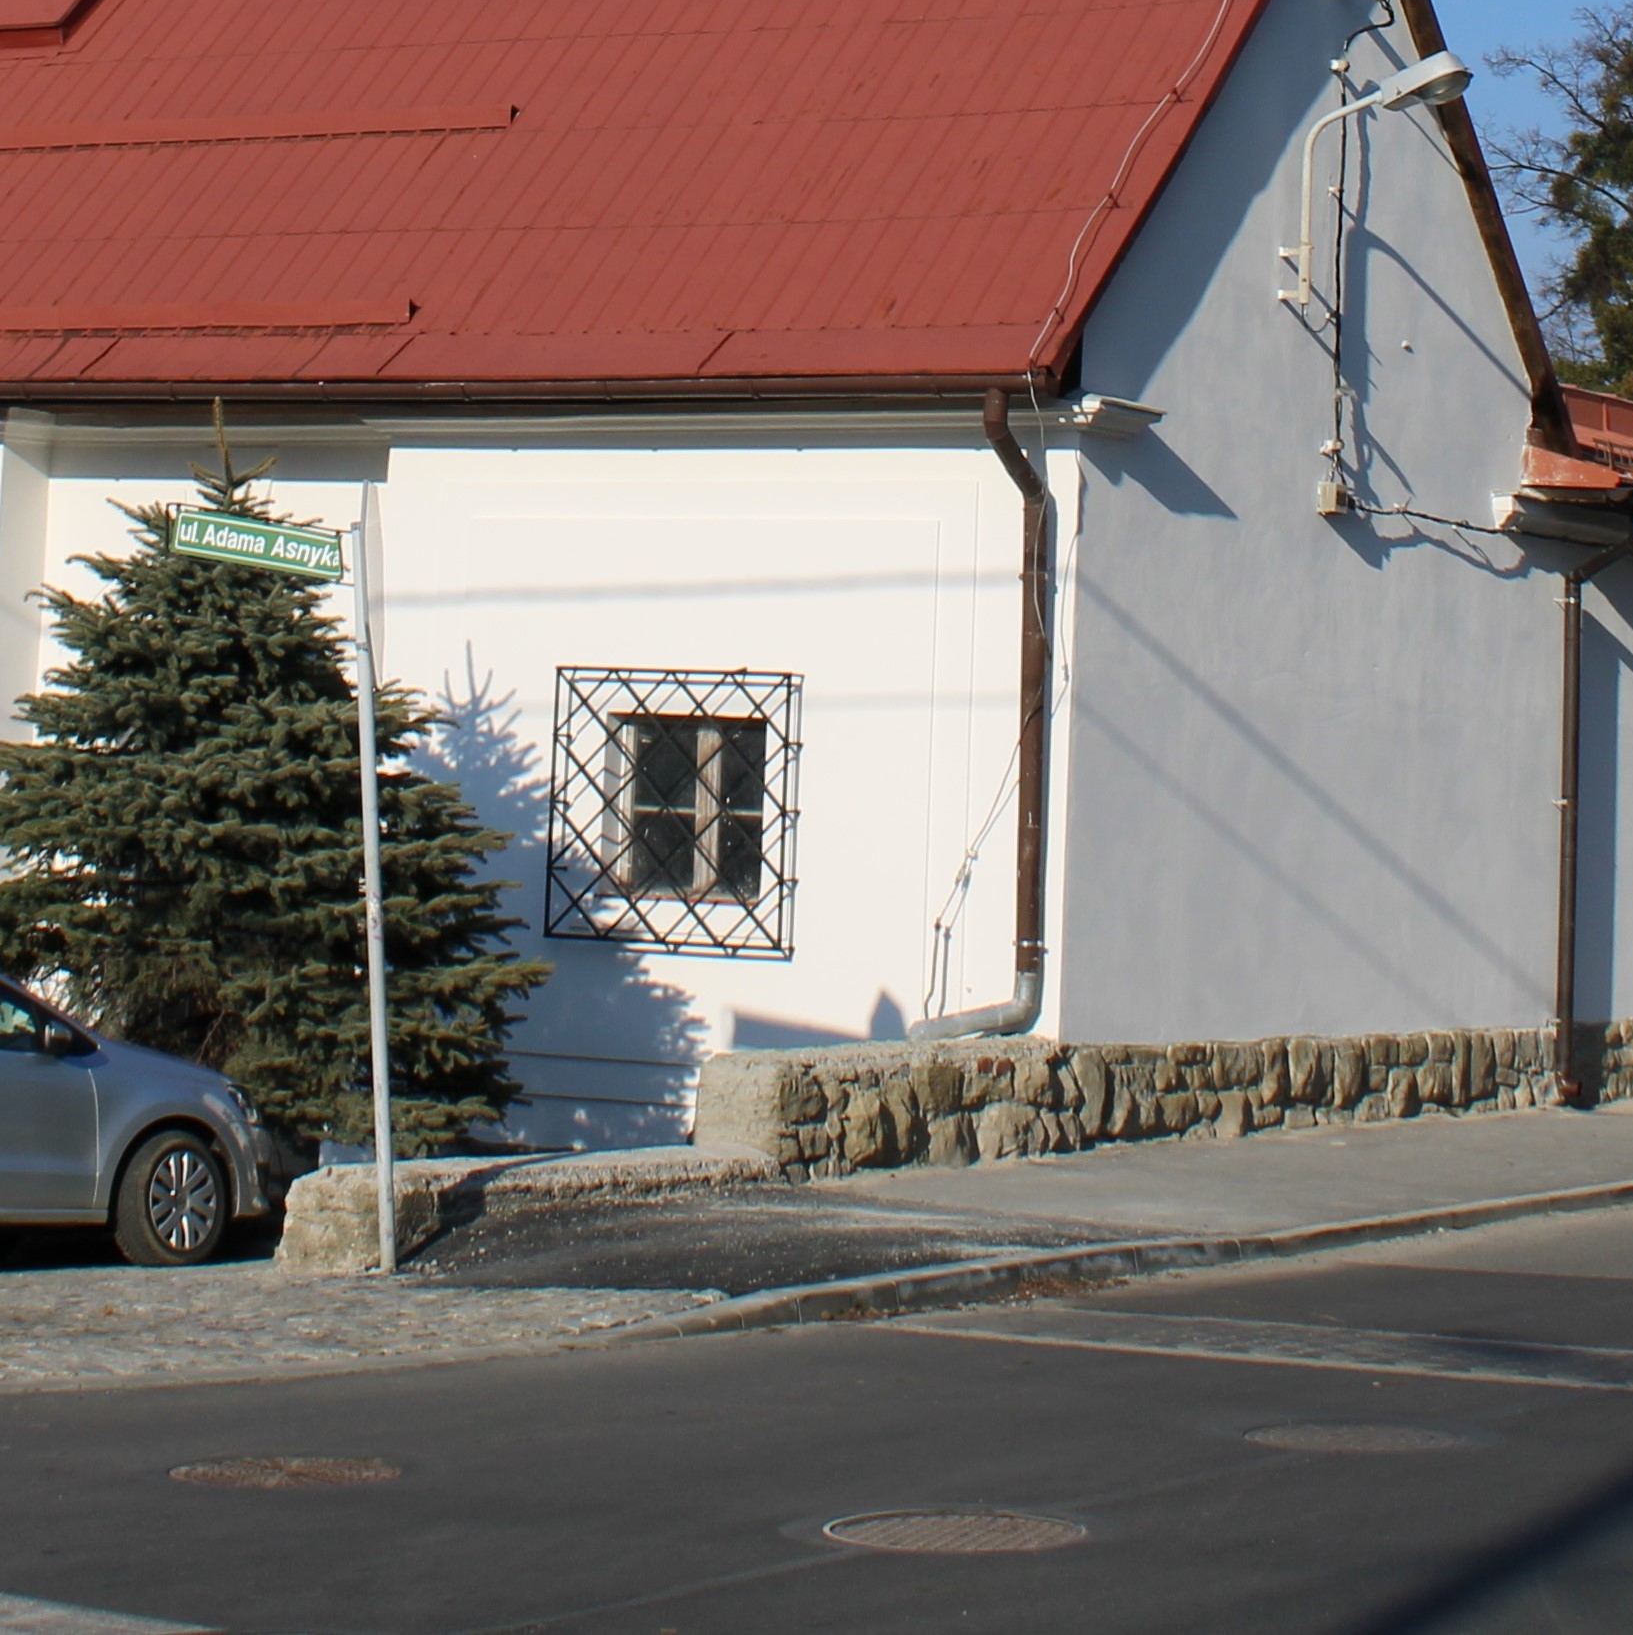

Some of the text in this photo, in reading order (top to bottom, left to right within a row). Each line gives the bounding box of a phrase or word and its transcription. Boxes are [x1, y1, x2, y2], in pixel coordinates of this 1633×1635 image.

[180, 521, 340, 568] ul. Adama Asnyka
